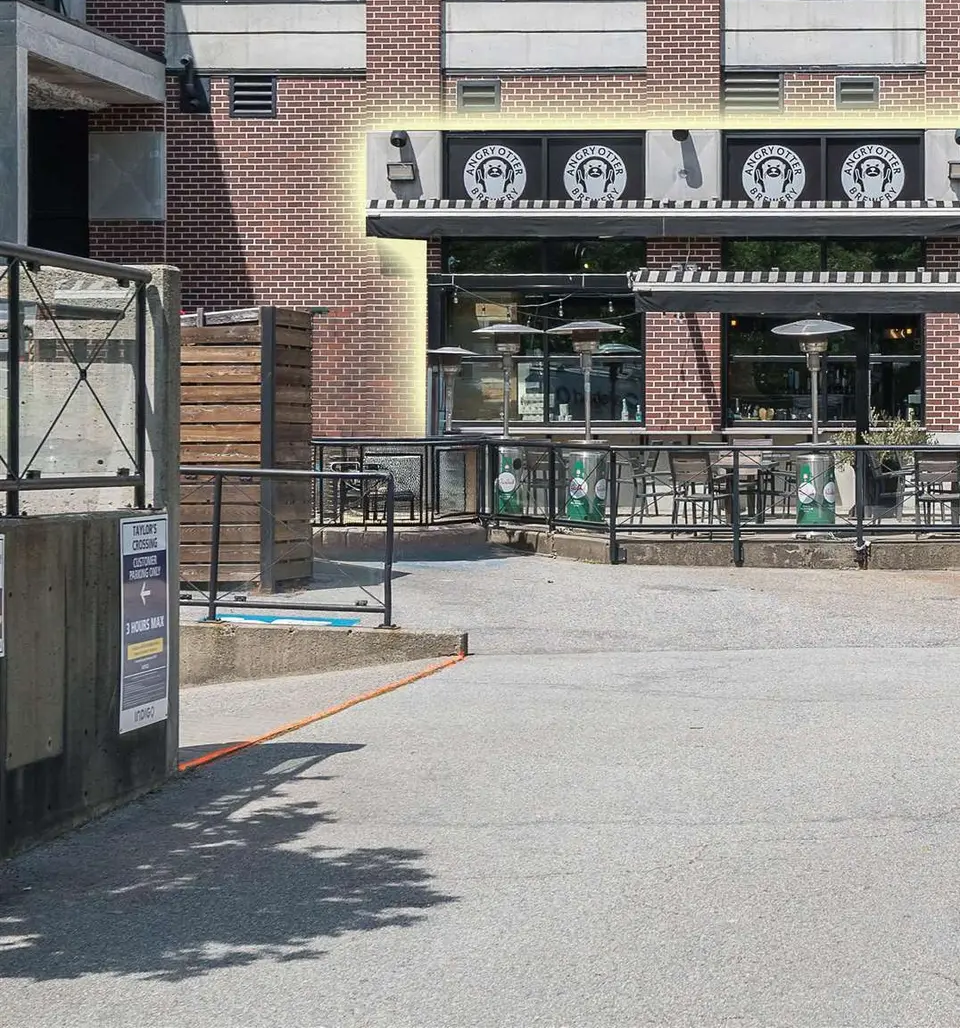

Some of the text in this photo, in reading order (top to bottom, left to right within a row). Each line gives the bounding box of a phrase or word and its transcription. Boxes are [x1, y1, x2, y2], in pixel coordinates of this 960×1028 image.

[466, 146, 523, 175] ANGRY OTTER
[566, 146, 623, 175] ANGRY OTTER
[744, 146, 802, 175] ANGRY OTTER
[844, 146, 901, 175] ANGRY OTTER
[471, 187, 519, 201] BRRY
[571, 187, 619, 201] BREERY
[132, 523, 157, 536] TAYLOR'S
[132, 537, 158, 551] CROSSING
[132, 555, 158, 568] CUSTOMER
[129, 567, 149, 581] PARKING
[126, 615, 165, 635] 3 HOURS MAX
